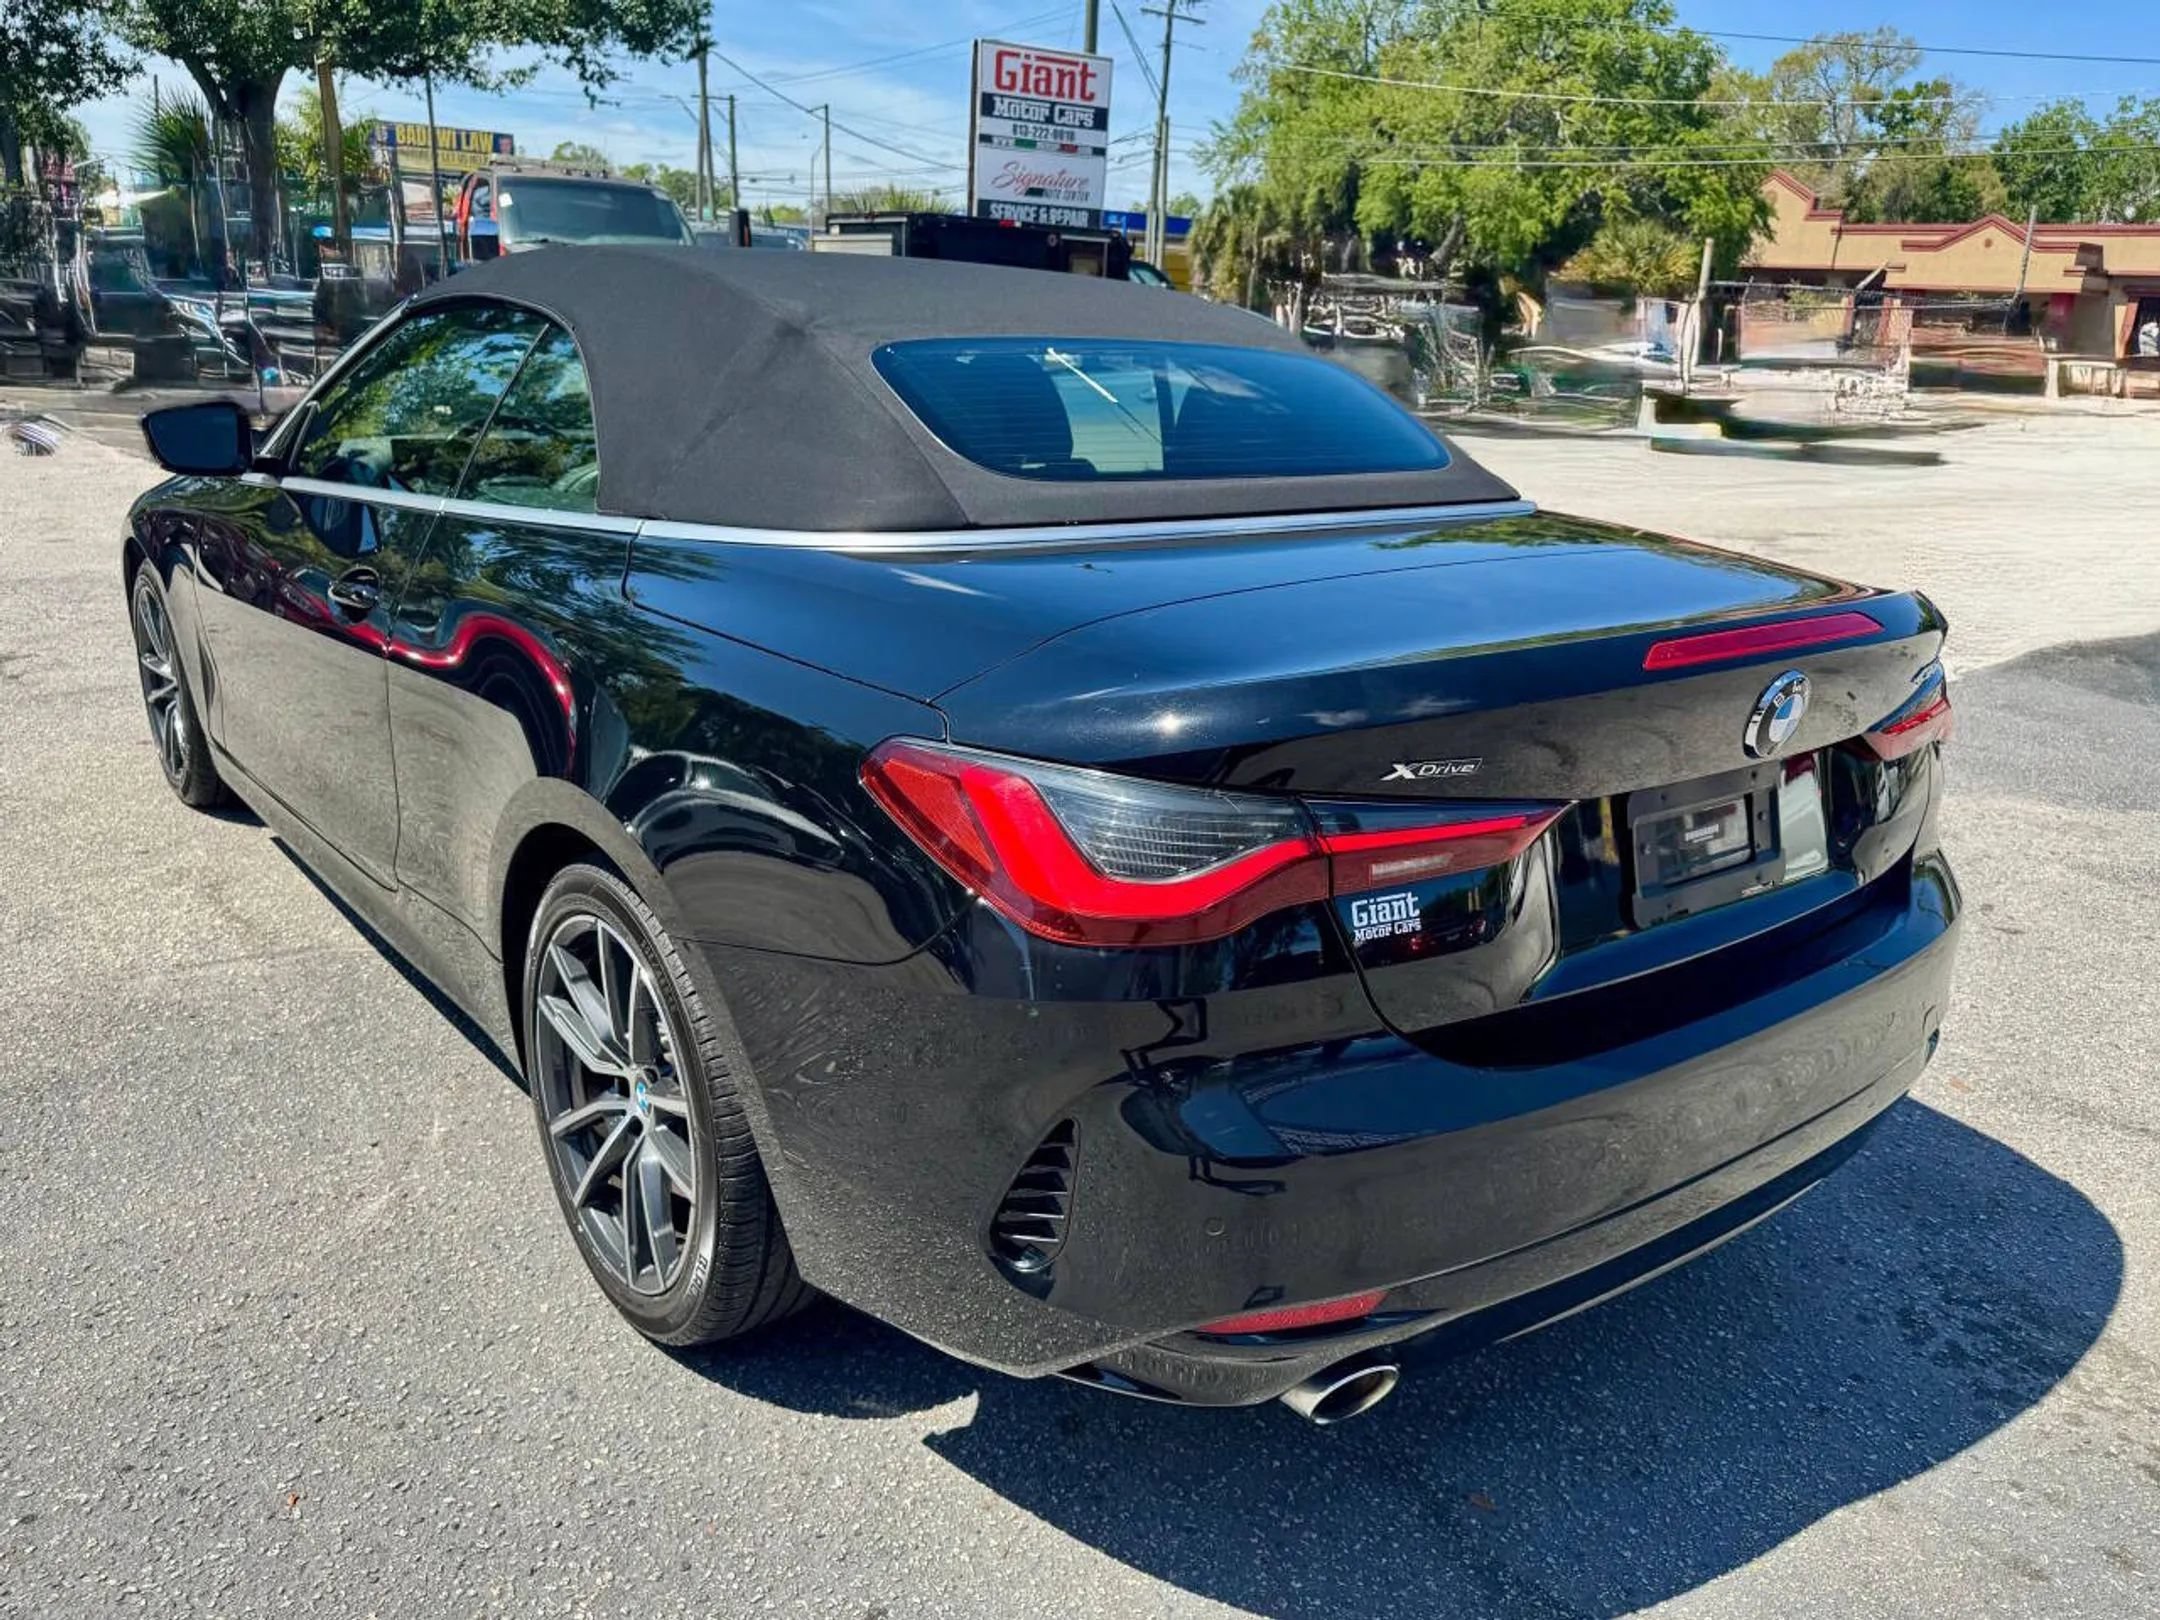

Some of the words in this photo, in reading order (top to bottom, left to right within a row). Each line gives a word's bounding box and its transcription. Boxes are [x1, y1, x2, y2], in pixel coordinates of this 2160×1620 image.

[995, 50, 1097, 102] Giant
[992, 96, 1051, 122] Motor
[1053, 100, 1095, 127] Cars
[461, 131, 493, 154] LAW
[991, 160, 1088, 196] Signature
[990, 202, 1038, 222] SERVICE
[1049, 208, 1089, 228] REPAIR
[1351, 891, 1420, 928] Giant
[1353, 923, 1392, 943] Motor
[1394, 918, 1422, 935] Cars
